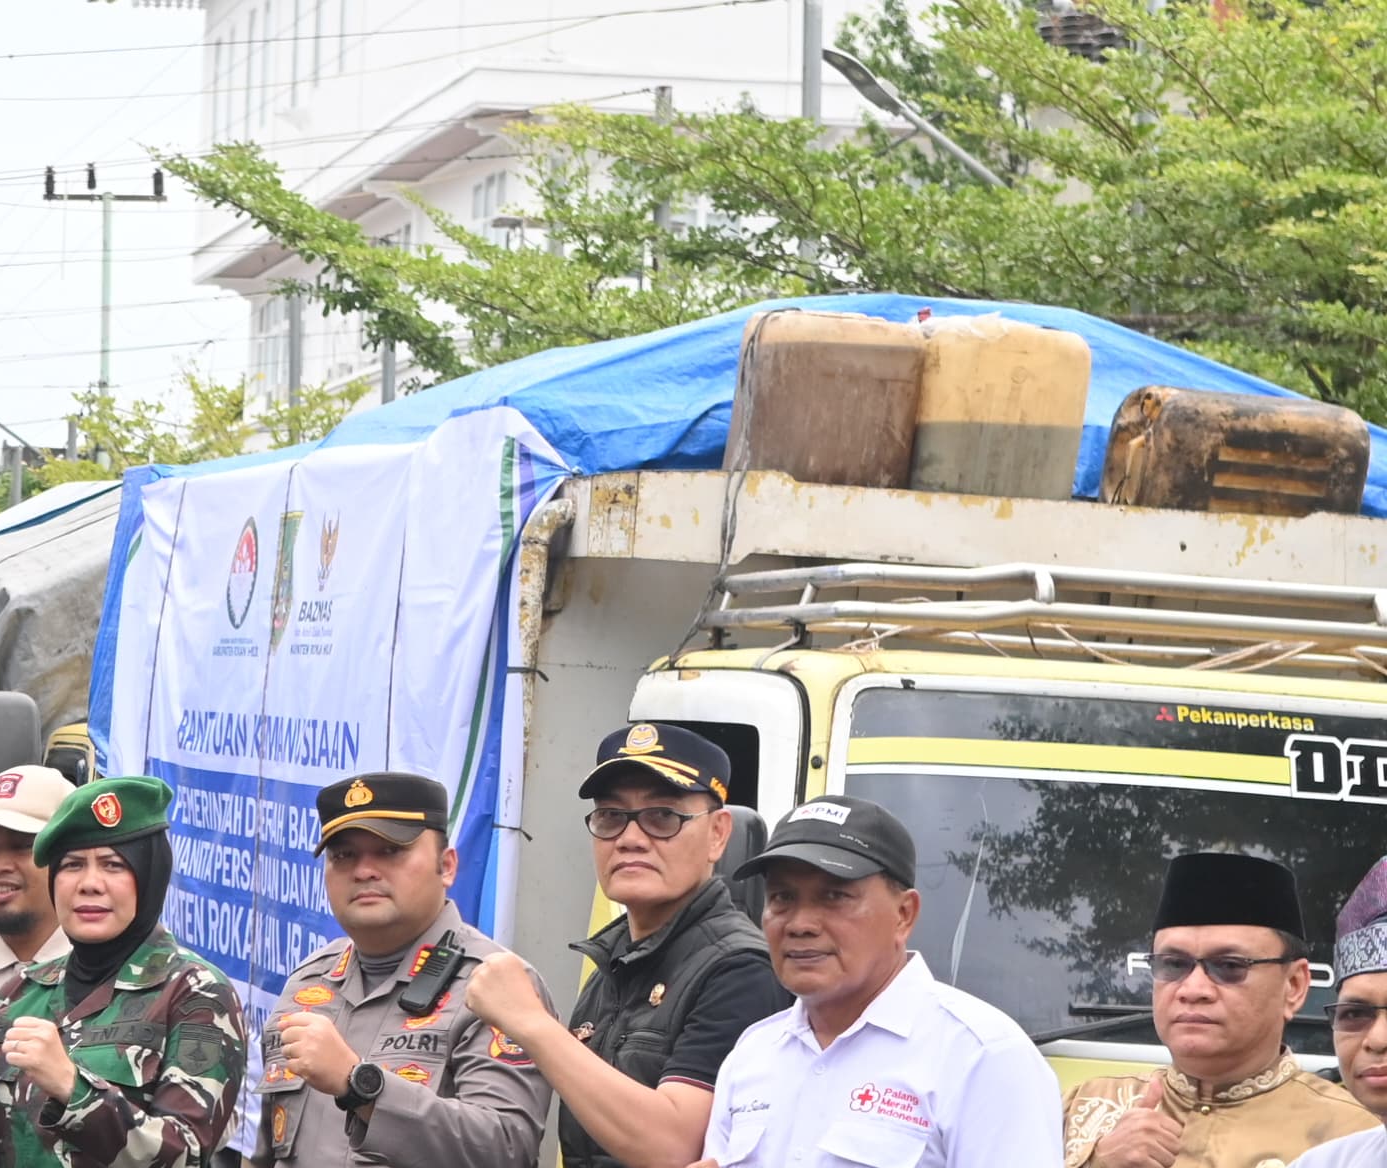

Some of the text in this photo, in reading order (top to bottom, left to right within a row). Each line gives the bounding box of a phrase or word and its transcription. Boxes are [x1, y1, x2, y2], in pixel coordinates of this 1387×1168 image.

[298, 600, 333, 622] BAZNAS
[1177, 705, 1315, 731] Pekanperkasa
[289, 805, 321, 853] BAZ
[282, 860, 310, 908] DAN
[90, 1028, 119, 1042] TNI
[382, 1034, 438, 1052] POLRI
[881, 1100, 913, 1113] Merah
[884, 1087, 919, 1106] Palang
[877, 1106, 930, 1128] Indonesia
